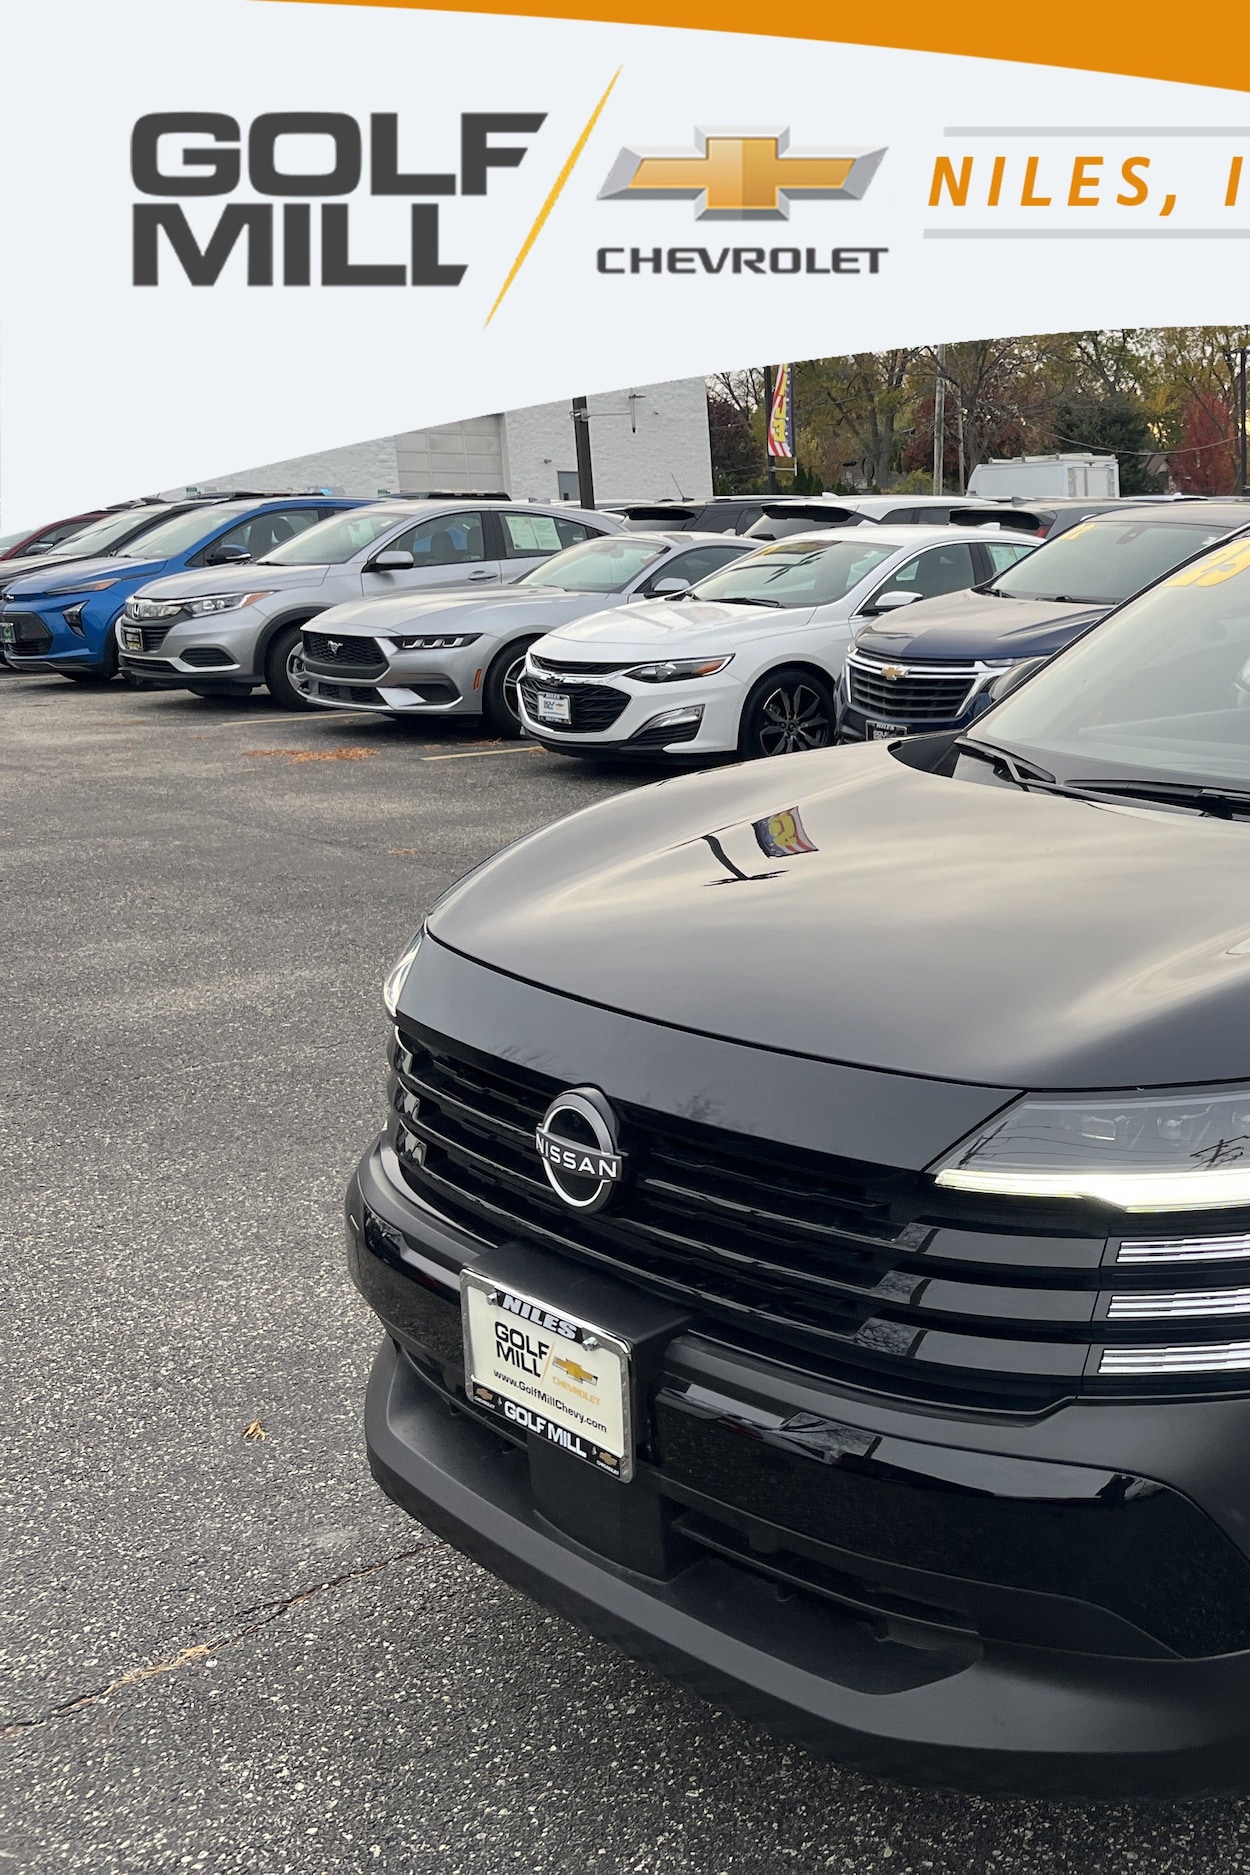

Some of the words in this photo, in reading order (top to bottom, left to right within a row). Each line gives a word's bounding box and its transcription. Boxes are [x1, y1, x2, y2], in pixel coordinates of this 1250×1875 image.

[535, 1133, 617, 1178] NISSAN
[502, 1294, 577, 1340] NILES
[495, 1321, 550, 1360] GOLF
[496, 1340, 541, 1378] MILL
[494, 1369, 607, 1433] www.GolfMillChevy.com
[553, 1376, 601, 1406] CHEVROLET
[504, 1400, 547, 1434] GOLF
[548, 1422, 588, 1458] MILL
